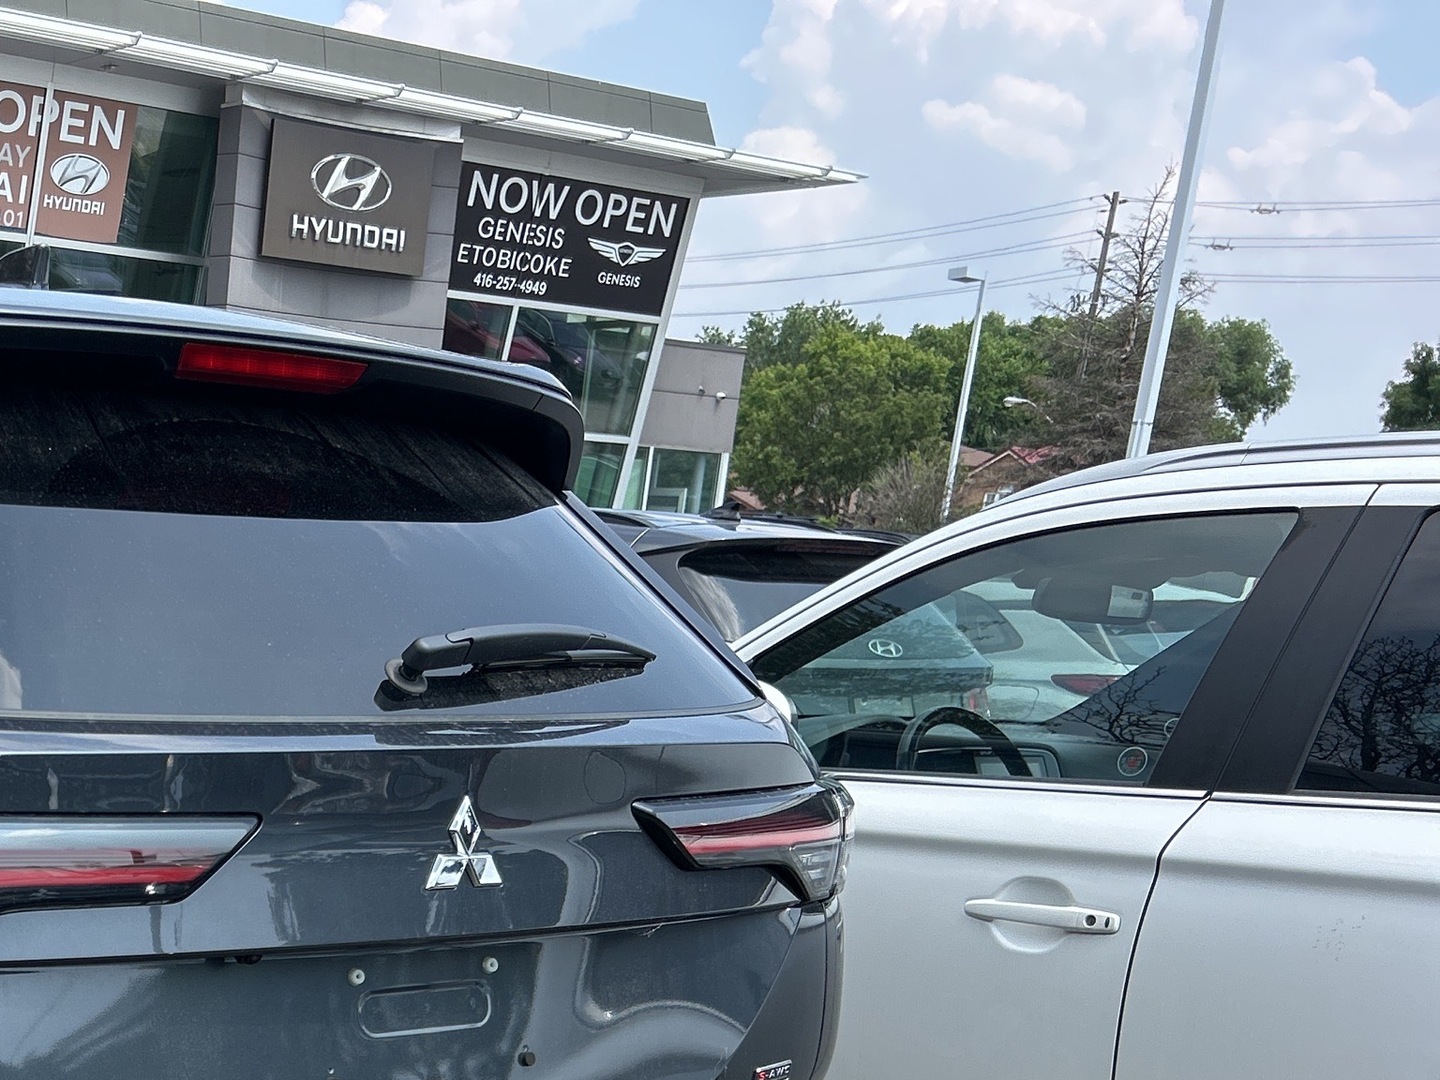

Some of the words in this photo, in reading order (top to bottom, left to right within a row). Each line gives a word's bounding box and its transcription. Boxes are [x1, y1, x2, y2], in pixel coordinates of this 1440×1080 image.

[43, 194, 105, 216] HYUNDAI
[466, 169, 571, 220] NOW
[575, 188, 678, 238] OPEN
[291, 213, 407, 253] HYUNDAI
[477, 216, 565, 249] GENESIS
[457, 243, 572, 278] ETOBICOKE
[473, 273, 547, 296] 416-257-4949
[597, 271, 641, 288] GENESIS
